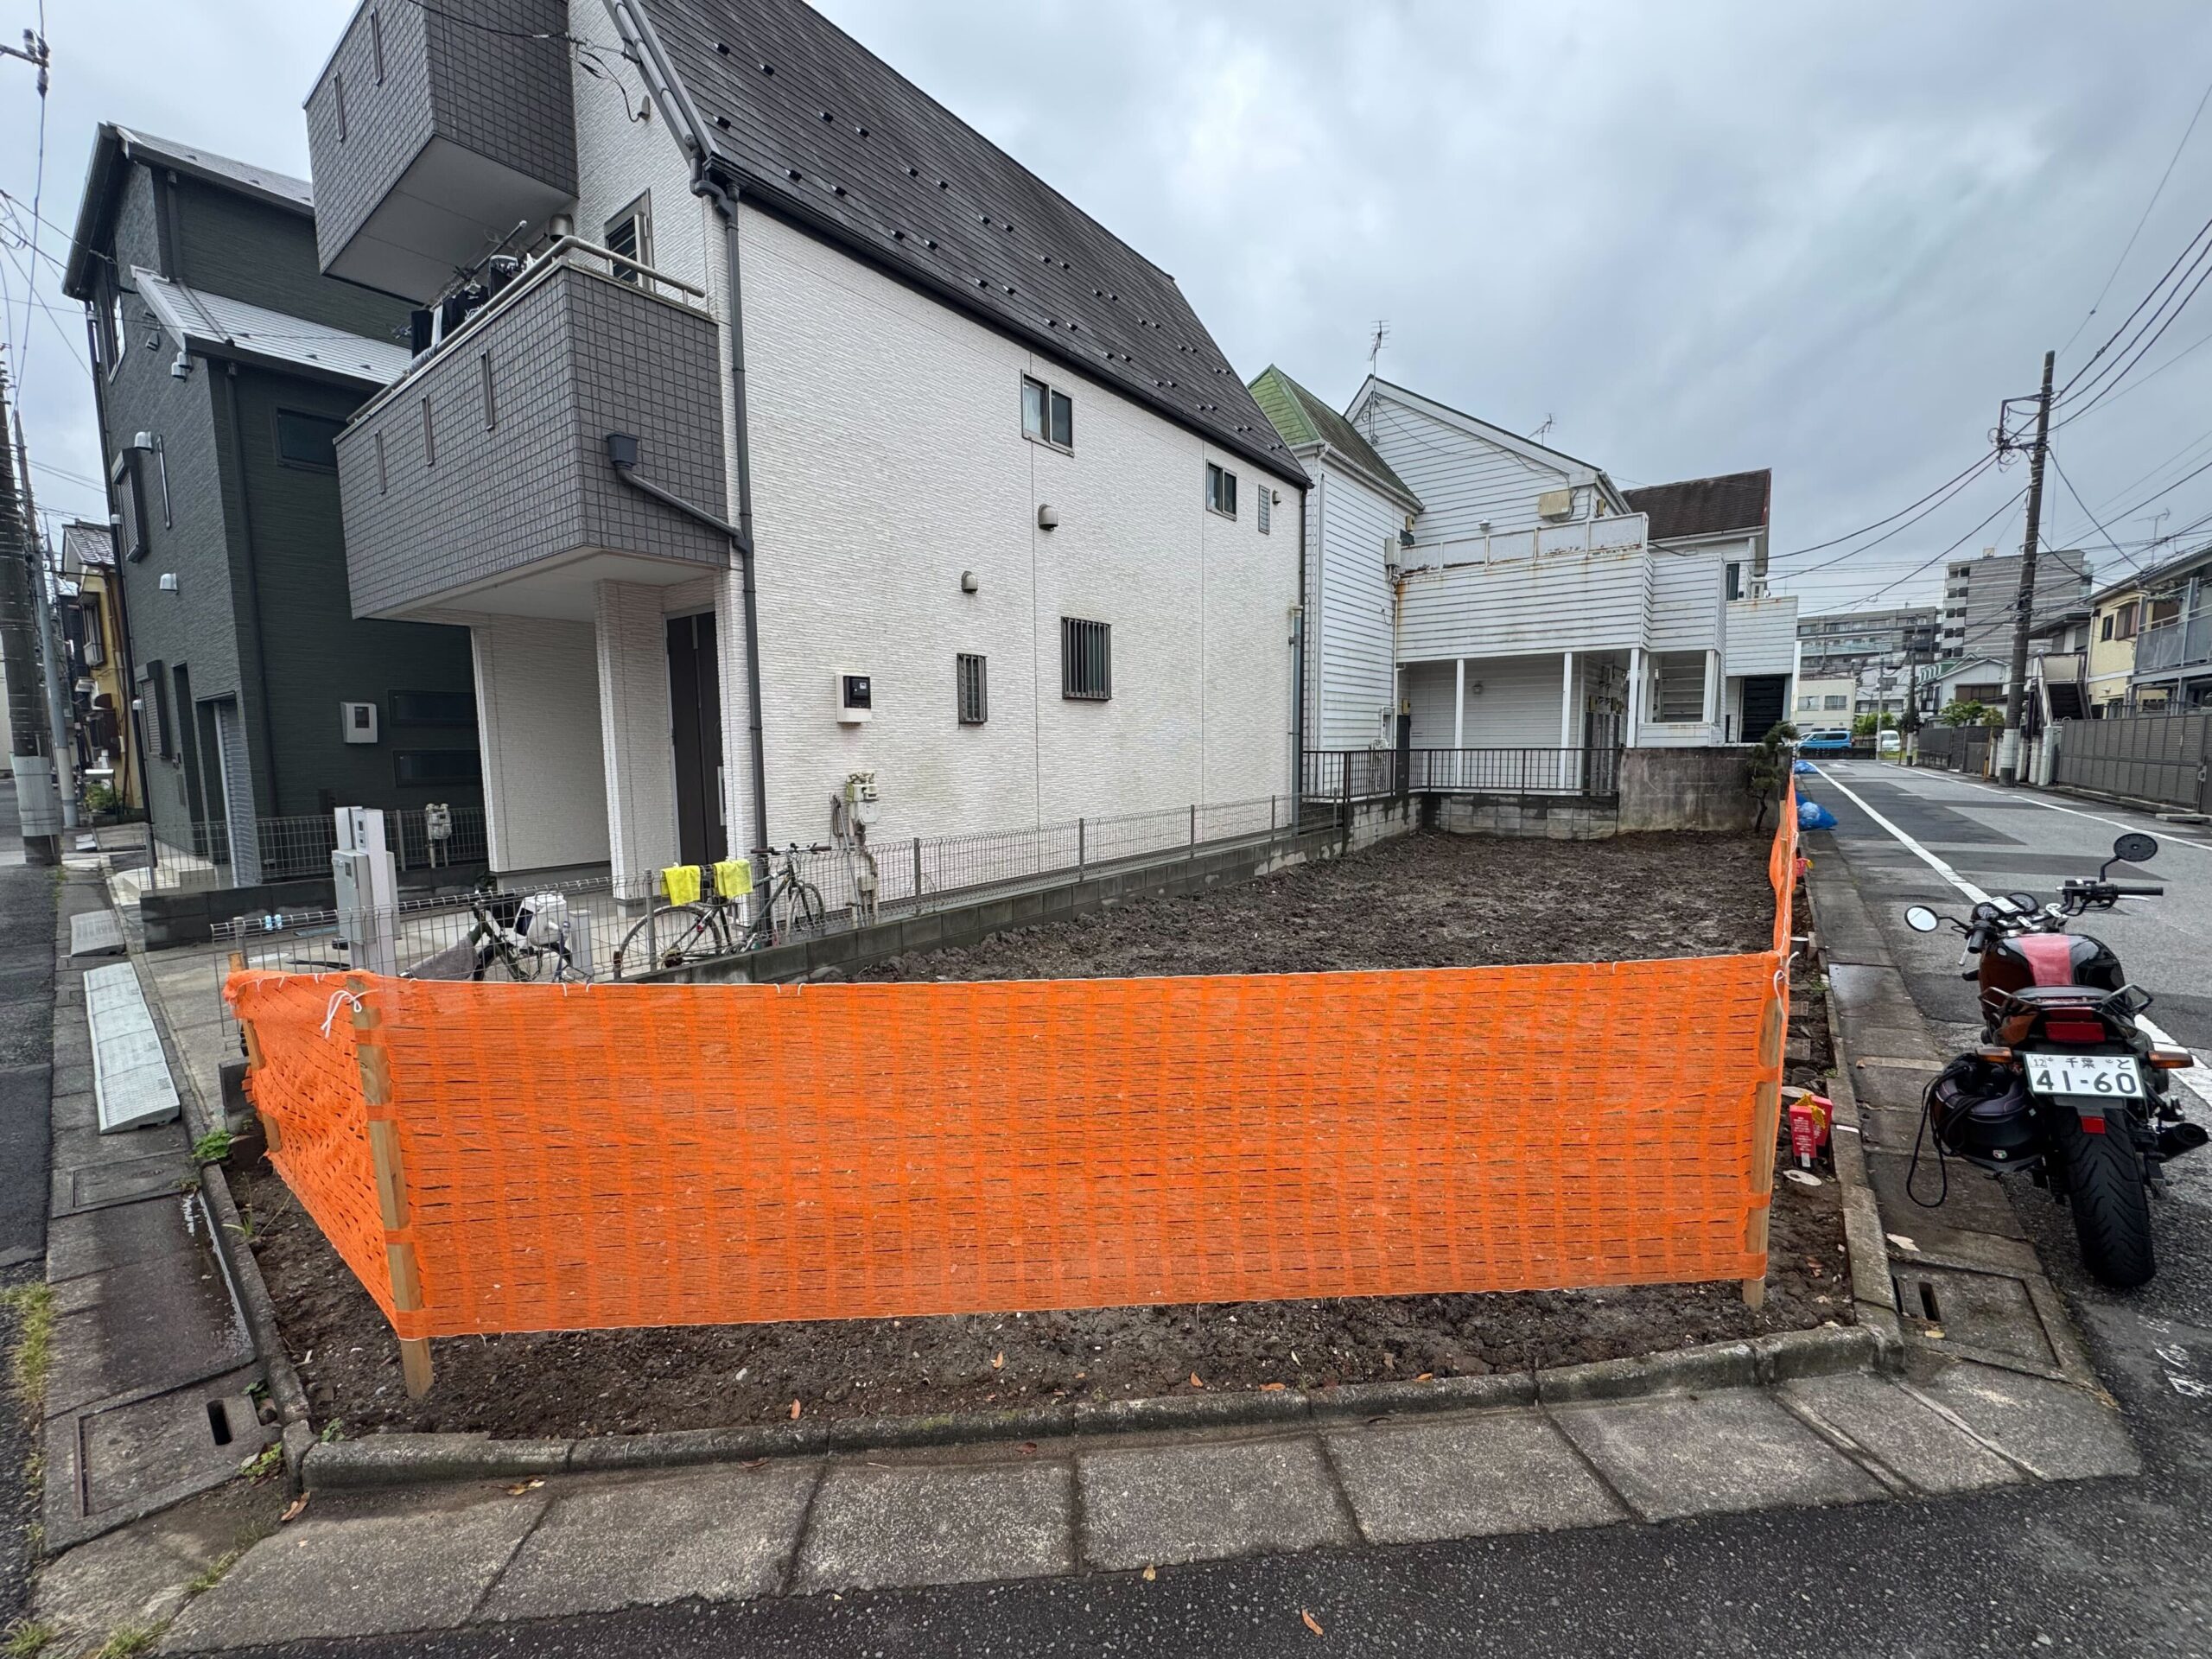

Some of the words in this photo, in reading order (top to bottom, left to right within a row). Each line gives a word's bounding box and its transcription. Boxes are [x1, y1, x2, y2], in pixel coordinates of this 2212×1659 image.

[2065, 1057, 2095, 1069] 千葉
[2116, 1059, 2132, 1070] と
[2036, 1070, 2137, 1094] 41-60
